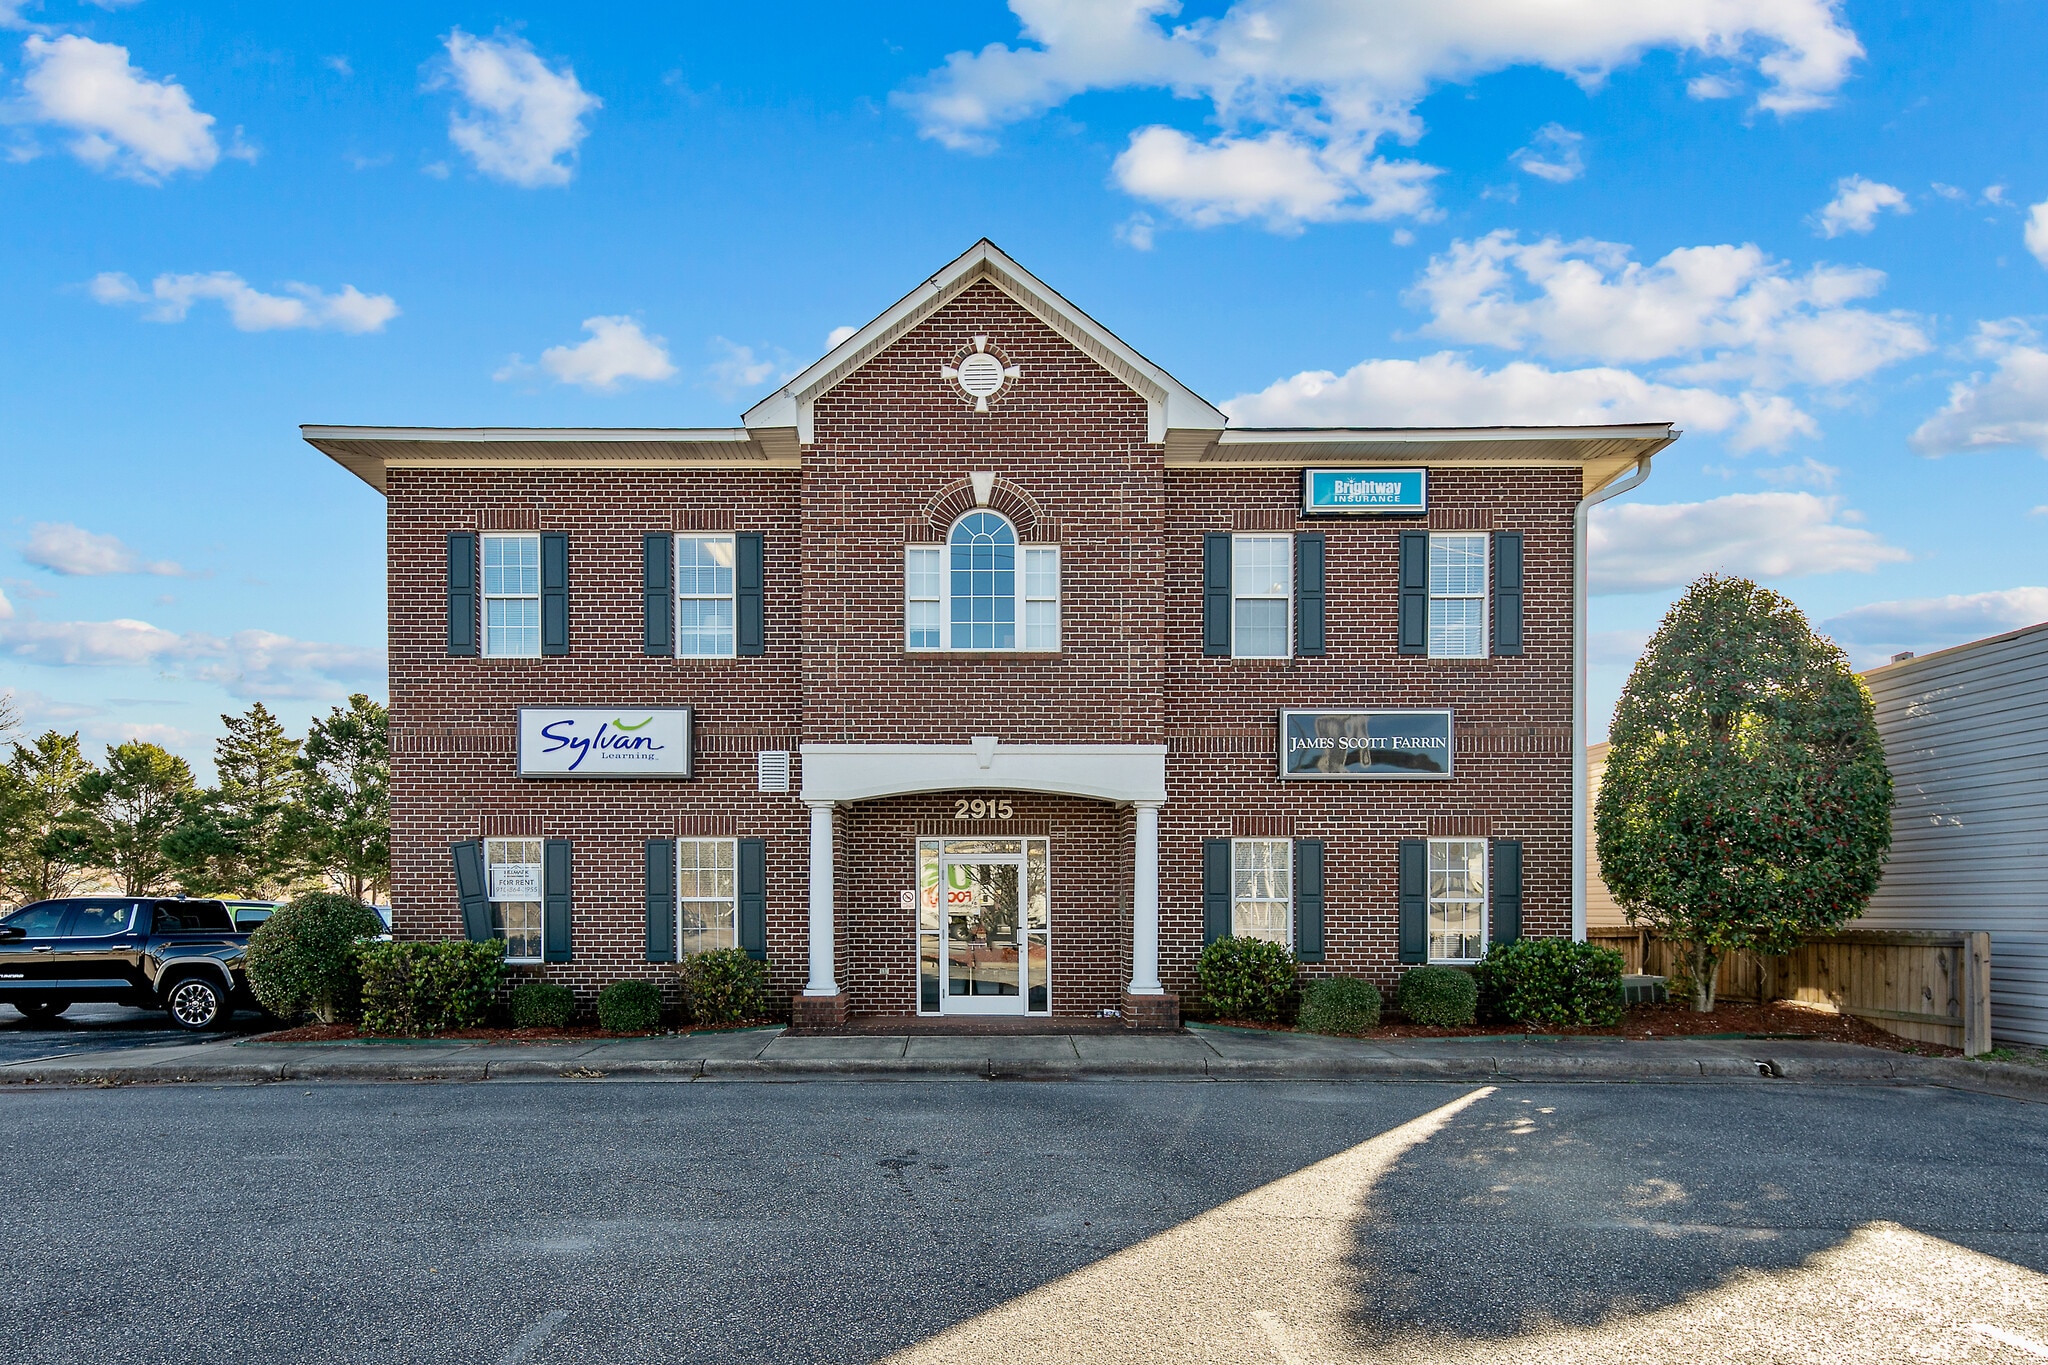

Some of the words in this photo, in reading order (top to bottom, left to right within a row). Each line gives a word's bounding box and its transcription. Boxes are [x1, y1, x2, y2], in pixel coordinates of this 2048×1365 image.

[1334, 479, 1402, 496] Brightway
[541, 719, 665, 771] Sylvan
[1290, 737, 1335, 752] JAMES
[1338, 736, 1388, 750] SCOTT
[1391, 736, 1447, 750] FARRIN
[601, 752, 655, 761] Learning
[954, 799, 1014, 819] 2915
